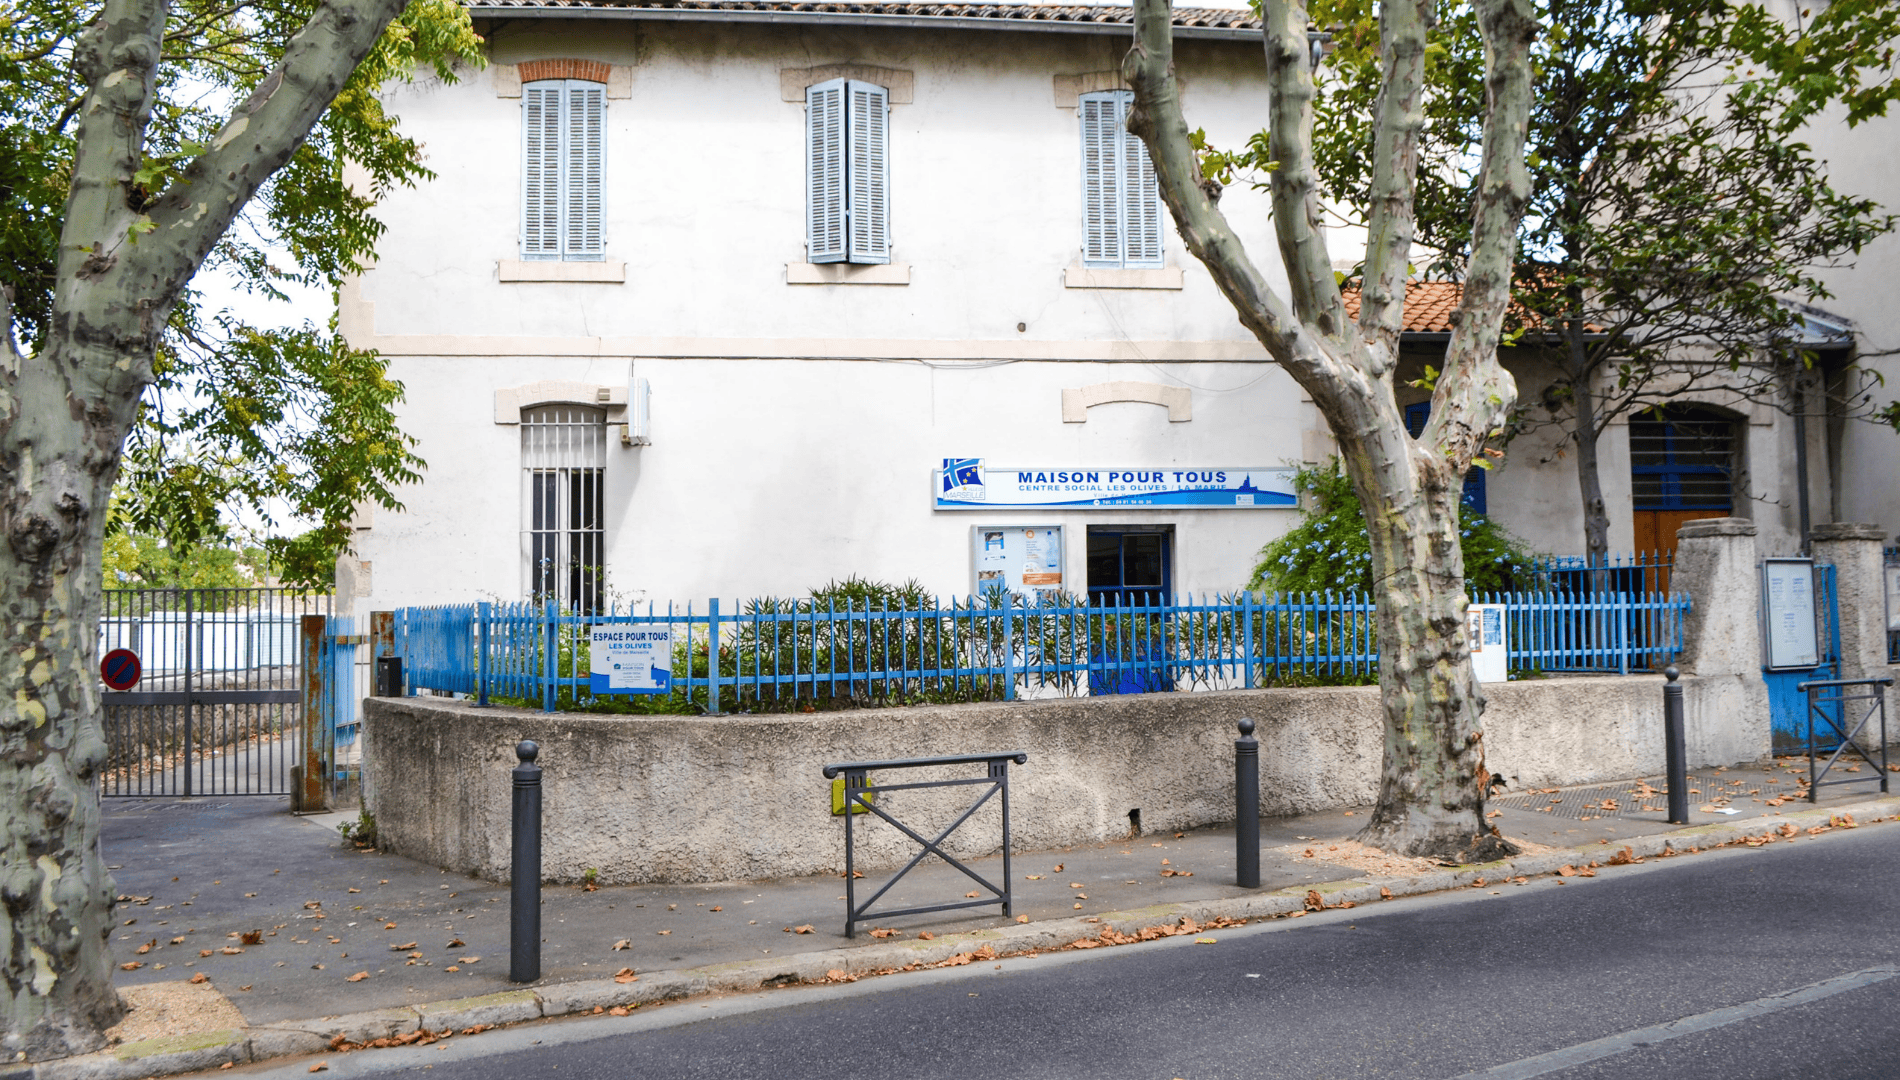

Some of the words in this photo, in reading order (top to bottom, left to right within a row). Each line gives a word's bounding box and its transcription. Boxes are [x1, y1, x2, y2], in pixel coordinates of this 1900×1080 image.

[1018, 472, 1099, 483] MAISON
[1109, 472, 1164, 483] POUR
[1173, 471, 1227, 483] TOUS
[593, 632, 623, 641] ESPACE
[625, 632, 646, 641] POUR
[648, 632, 669, 641] TOUS
